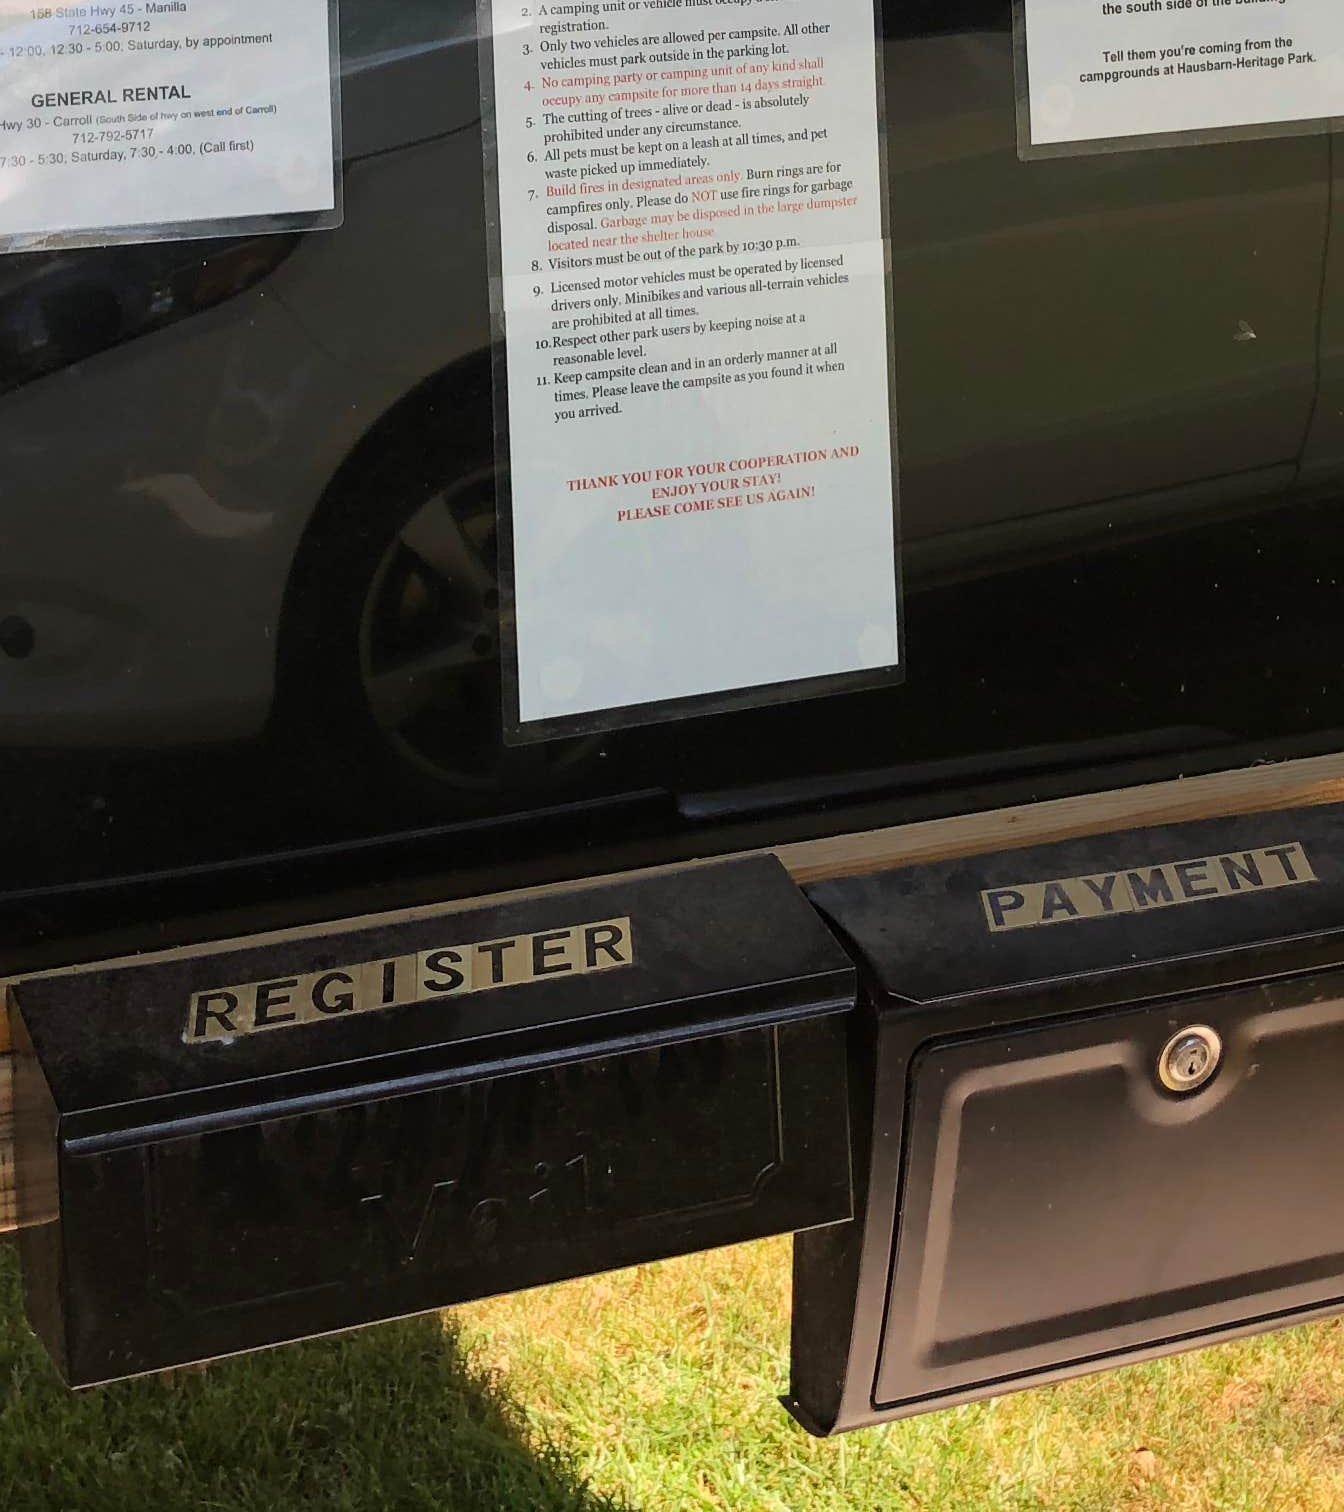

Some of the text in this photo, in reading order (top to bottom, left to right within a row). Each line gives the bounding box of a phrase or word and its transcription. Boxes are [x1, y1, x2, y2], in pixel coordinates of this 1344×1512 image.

[1102, 2, 1122, 15] the
[539, 38, 567, 54] Only
[570, 39, 591, 50] two
[593, 34, 639, 48] vehicles
[641, 36, 659, 45] are
[662, 29, 704, 44] allowed
[707, 31, 726, 44] per
[728, 26, 780, 41] campsite.
[783, 24, 798, 36] All
[800, 23, 830, 34] other
[1102, 36, 1293, 63] Tell them you're coming from the
[1079, 51, 1316, 83] campgrounds at Hausbarn-Heritage Park.
[31, 84, 191, 108] GENERAL RENTAL
[71, 148, 126, 163] Saturday,
[199, 141, 226, 156] (Call
[228, 139, 254, 152] first)
[531, 238, 800, 271] 8. Visitors must be out of the park by 10:30 p.m.
[566, 446, 859, 491] THANK YOU FOR YOUR COOPERATION AND
[652, 472, 780, 499] ENJOY YOUR STAY!
[617, 485, 815, 522] PLEASE COME SEE US AGAIN!
[987, 846, 1298, 926] PAYMENT
[193, 924, 625, 1037] REGISTER
